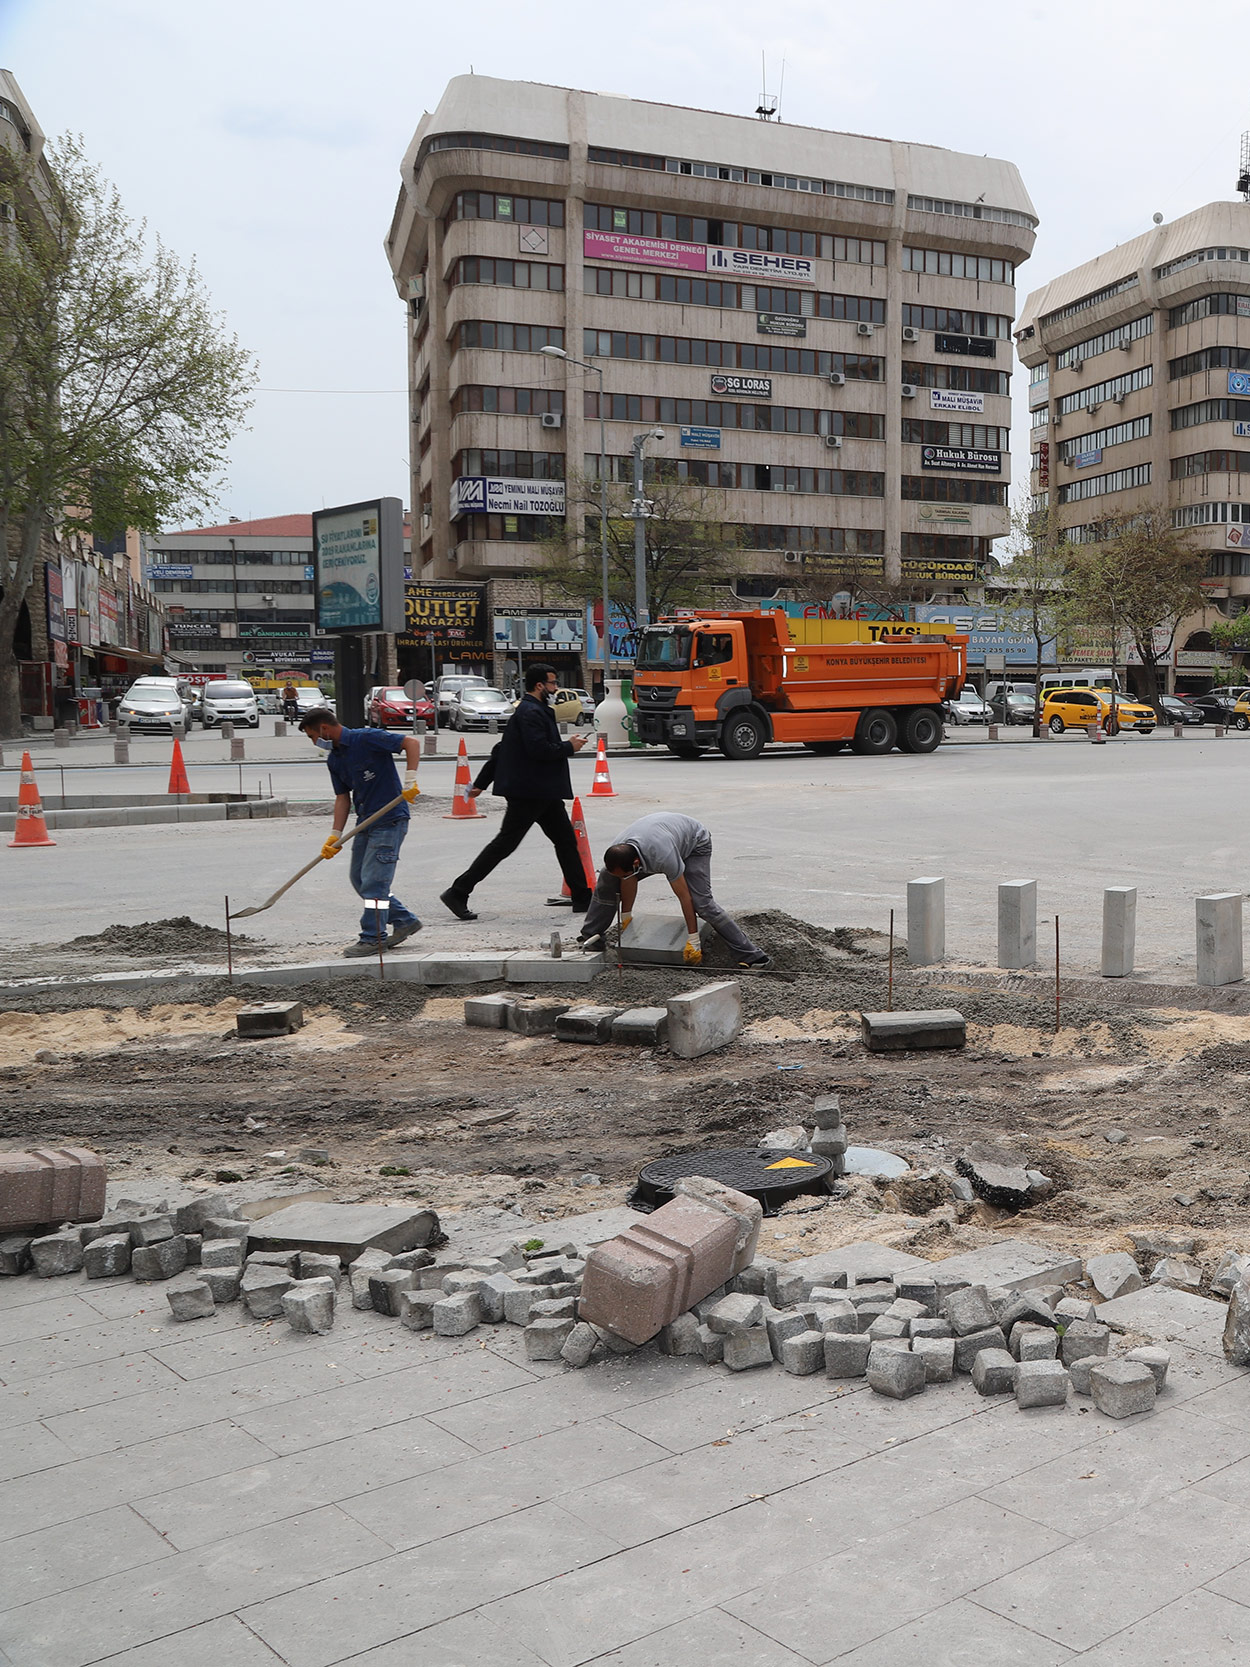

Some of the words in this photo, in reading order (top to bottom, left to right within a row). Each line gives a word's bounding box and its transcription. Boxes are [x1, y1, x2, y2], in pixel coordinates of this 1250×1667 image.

[585, 231, 621, 244] SİYASET
[622, 238, 668, 250] AKADEMİSİ
[670, 243, 706, 255] DERNEĞİ
[613, 246, 641, 255] GENEL
[643, 249, 679, 260] MERKEZİ
[732, 252, 811, 272] SEHER
[750, 266, 782, 274] DENETİM
[727, 377, 740, 388] SG
[742, 379, 770, 391] LORAS
[936, 449, 966, 459] Hukuk
[967, 451, 998, 462] Bürosu
[504, 484, 526, 494] YEMİNLİ
[526, 484, 540, 495] MALİ
[540, 484, 564, 496] MÜŞAVİR
[488, 499, 512, 510] Necmi
[513, 500, 528, 511] Nail
[529, 499, 564, 512] TOZOĞLU
[934, 571, 974, 581] BÜROSU
[405, 599, 480, 618] OUTLET
[409, 616, 475, 627] MAĞAZASI
[451, 638, 484, 647] ÜRÜNLER
[972, 636, 1004, 644] BAYAN
[1007, 635, 1034, 644] GİYİM
[450, 651, 494, 660] LAME
[826, 658, 848, 666] KONYA
[849, 657, 890, 666] BÜYÜKŞEHİR
[891, 656, 927, 665] BELEDİYESİ
